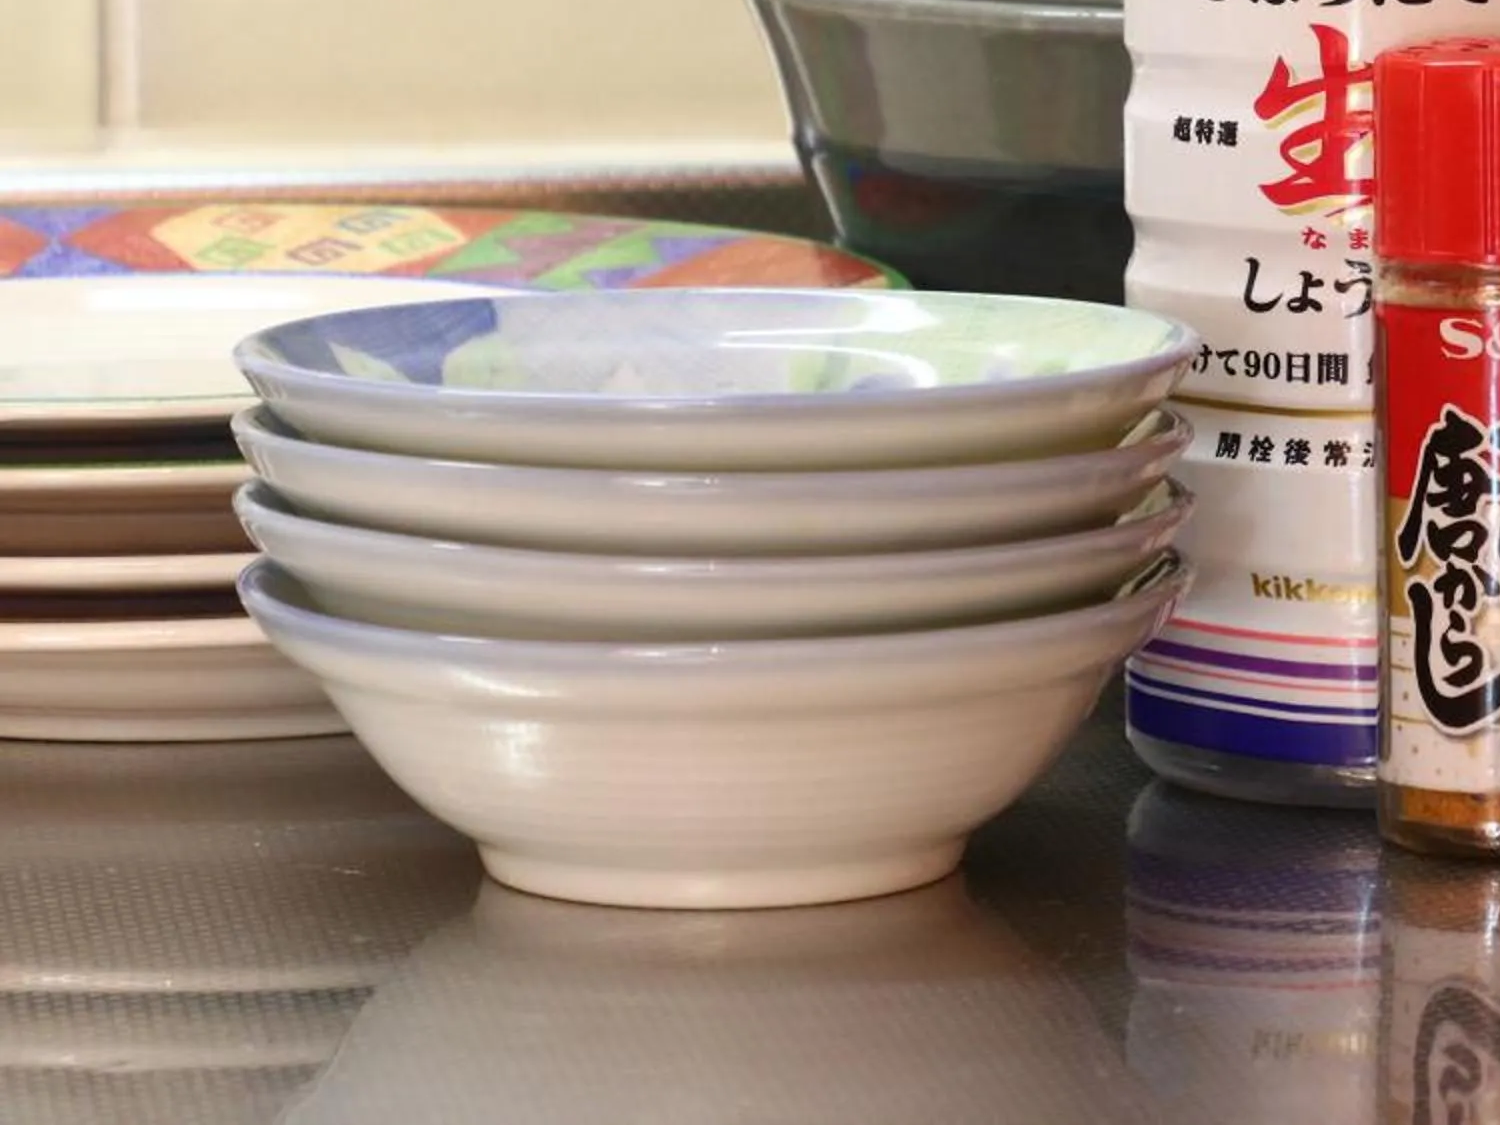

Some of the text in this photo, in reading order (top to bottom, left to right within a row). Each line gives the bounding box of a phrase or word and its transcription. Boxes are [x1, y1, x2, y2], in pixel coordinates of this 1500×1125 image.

[1173, 116, 1239, 147] 超特選
[1302, 227, 1370, 250] なま
